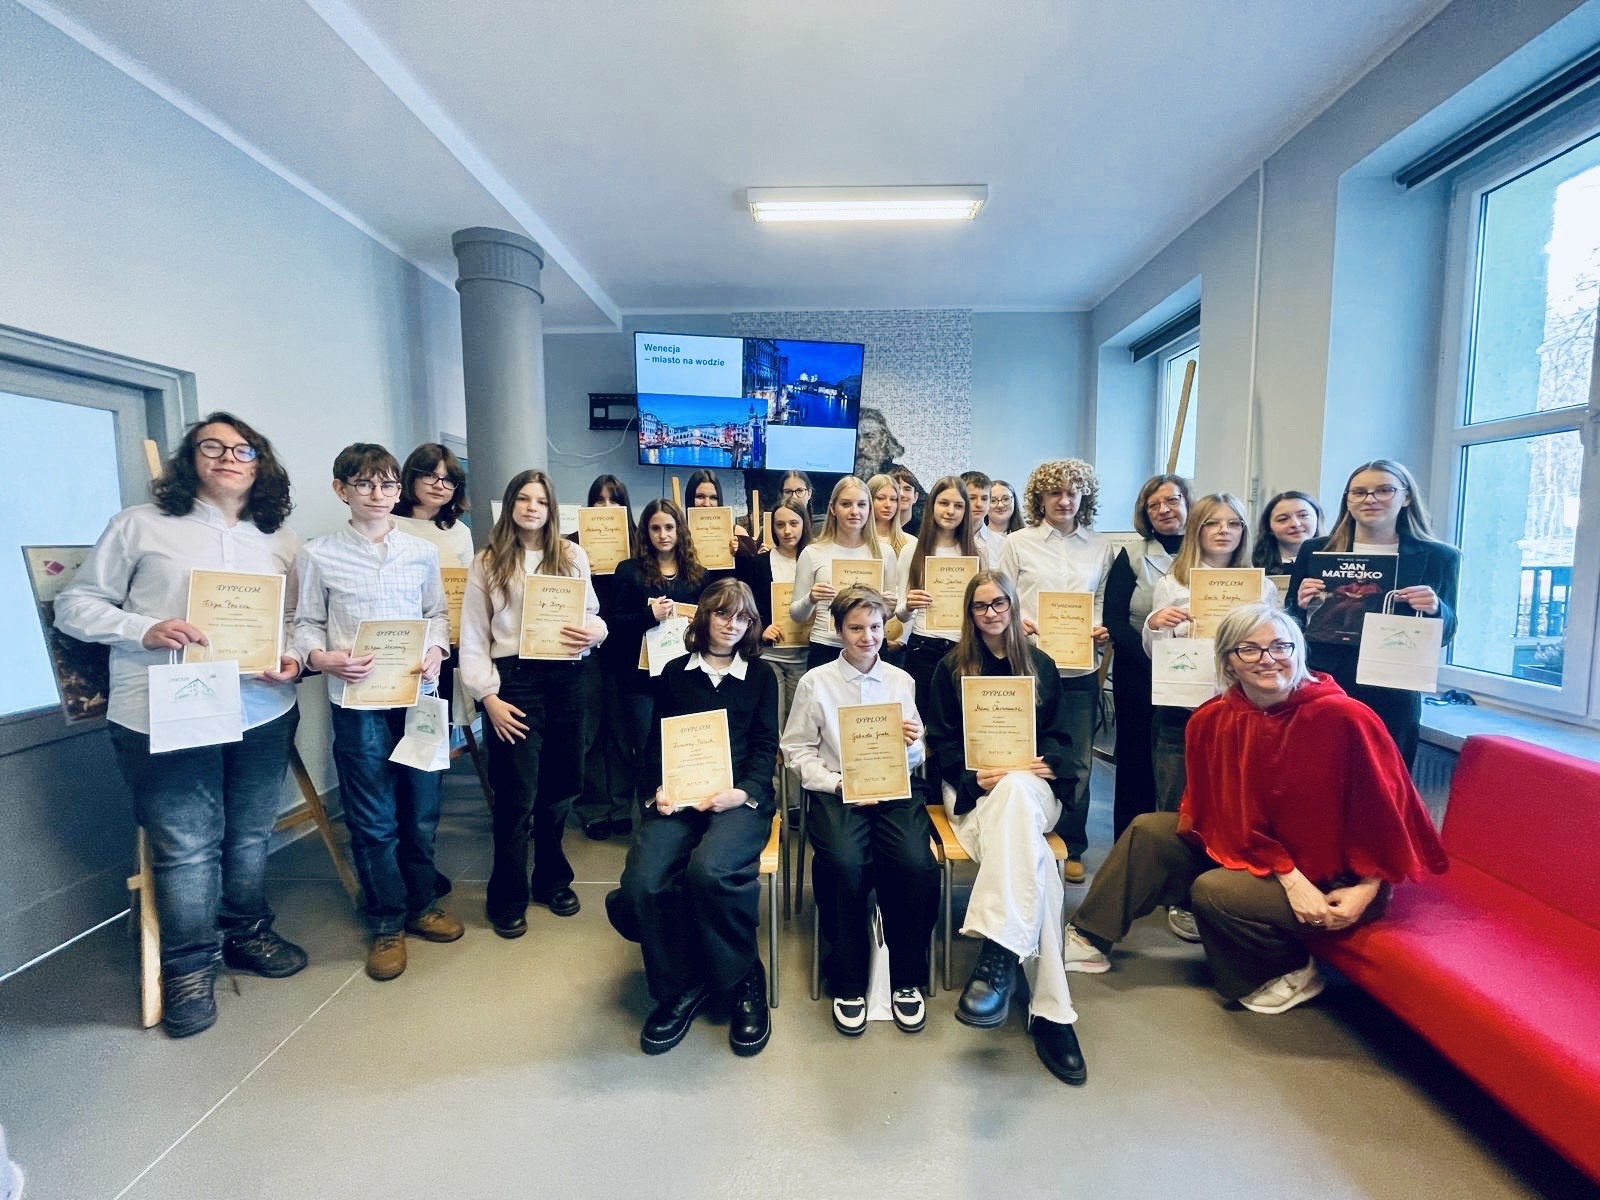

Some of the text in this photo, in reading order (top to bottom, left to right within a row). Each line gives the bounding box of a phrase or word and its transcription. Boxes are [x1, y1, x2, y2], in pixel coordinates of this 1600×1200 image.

[644, 343, 681, 354] Wenecja
[652, 356, 681, 364] miasto
[696, 358, 725, 366] wodzie
[1339, 562, 1366, 571] JAN
[1322, 570, 1383, 579] MATEJKO
[216, 584, 261, 593] DYPLOM
[542, 586, 571, 594] DYPLOM
[982, 689, 1016, 697] DYPLOM
[856, 715, 887, 724] DYPLOM
[680, 724, 711, 734] DYPLOM
